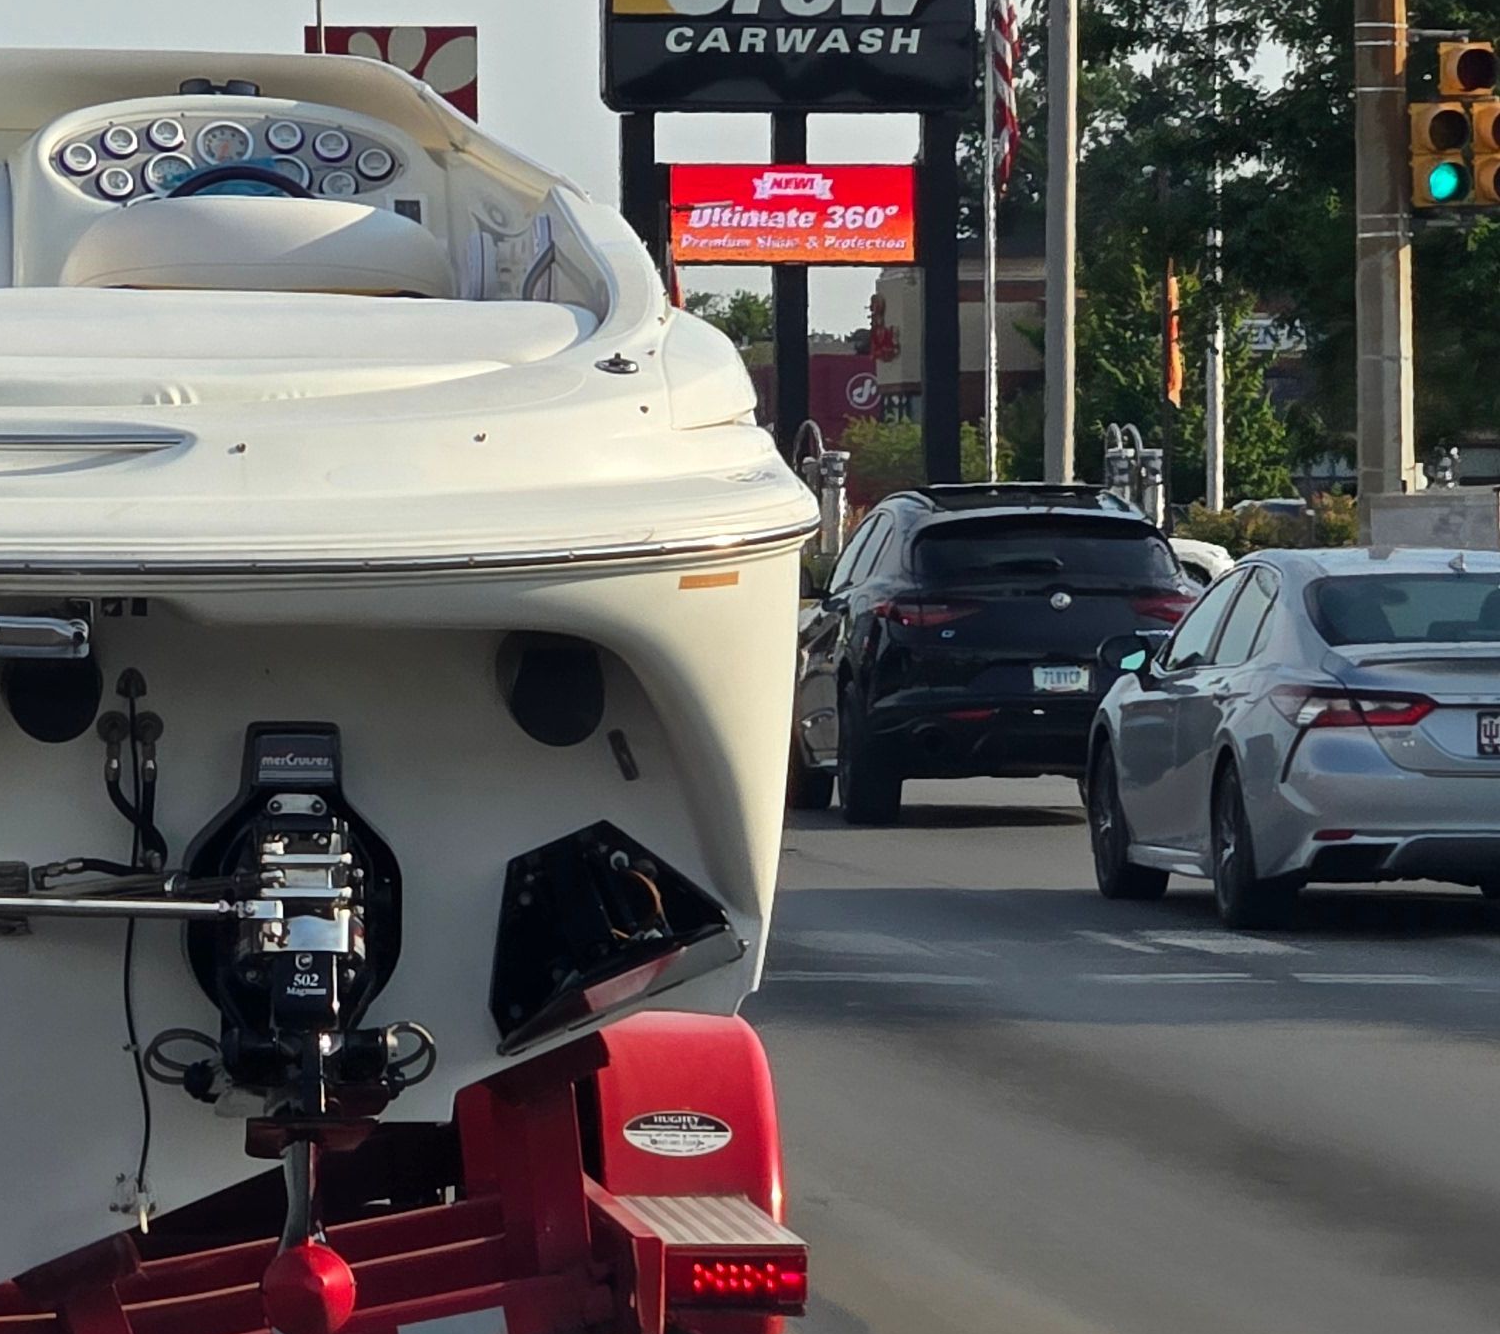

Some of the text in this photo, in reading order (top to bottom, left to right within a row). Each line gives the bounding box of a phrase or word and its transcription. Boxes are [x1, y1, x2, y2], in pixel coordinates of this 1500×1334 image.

[664, 26, 921, 55] CARWASH
[687, 205, 900, 229] Ultimate 360°
[680, 233, 752, 249] Premium
[805, 235, 820, 250] &
[823, 235, 907, 250] Protection
[292, 973, 320, 987] 502
